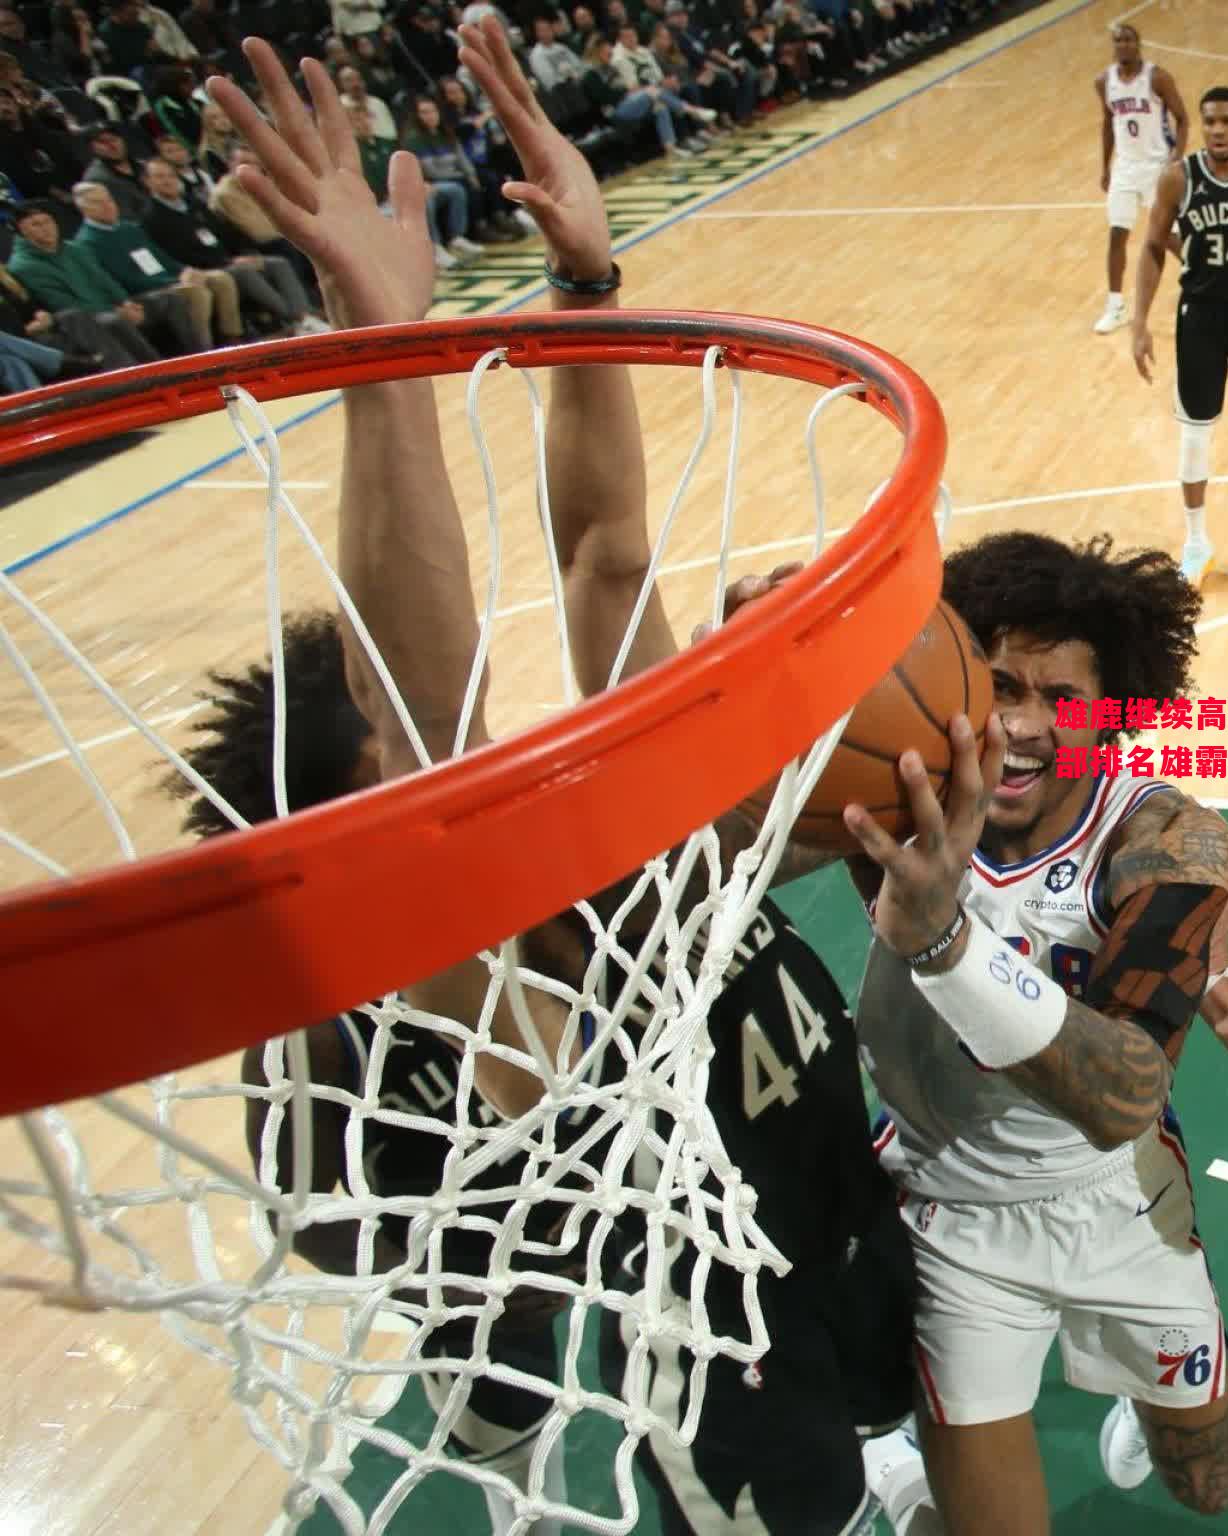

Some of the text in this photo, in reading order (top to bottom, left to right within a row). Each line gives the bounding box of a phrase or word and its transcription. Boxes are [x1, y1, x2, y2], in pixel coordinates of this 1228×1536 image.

[1127, 119, 1139, 138] 0
[1024, 898, 1085, 913] crypto.com
[741, 962, 831, 1121] 44
[1156, 1344, 1211, 1387] 76
